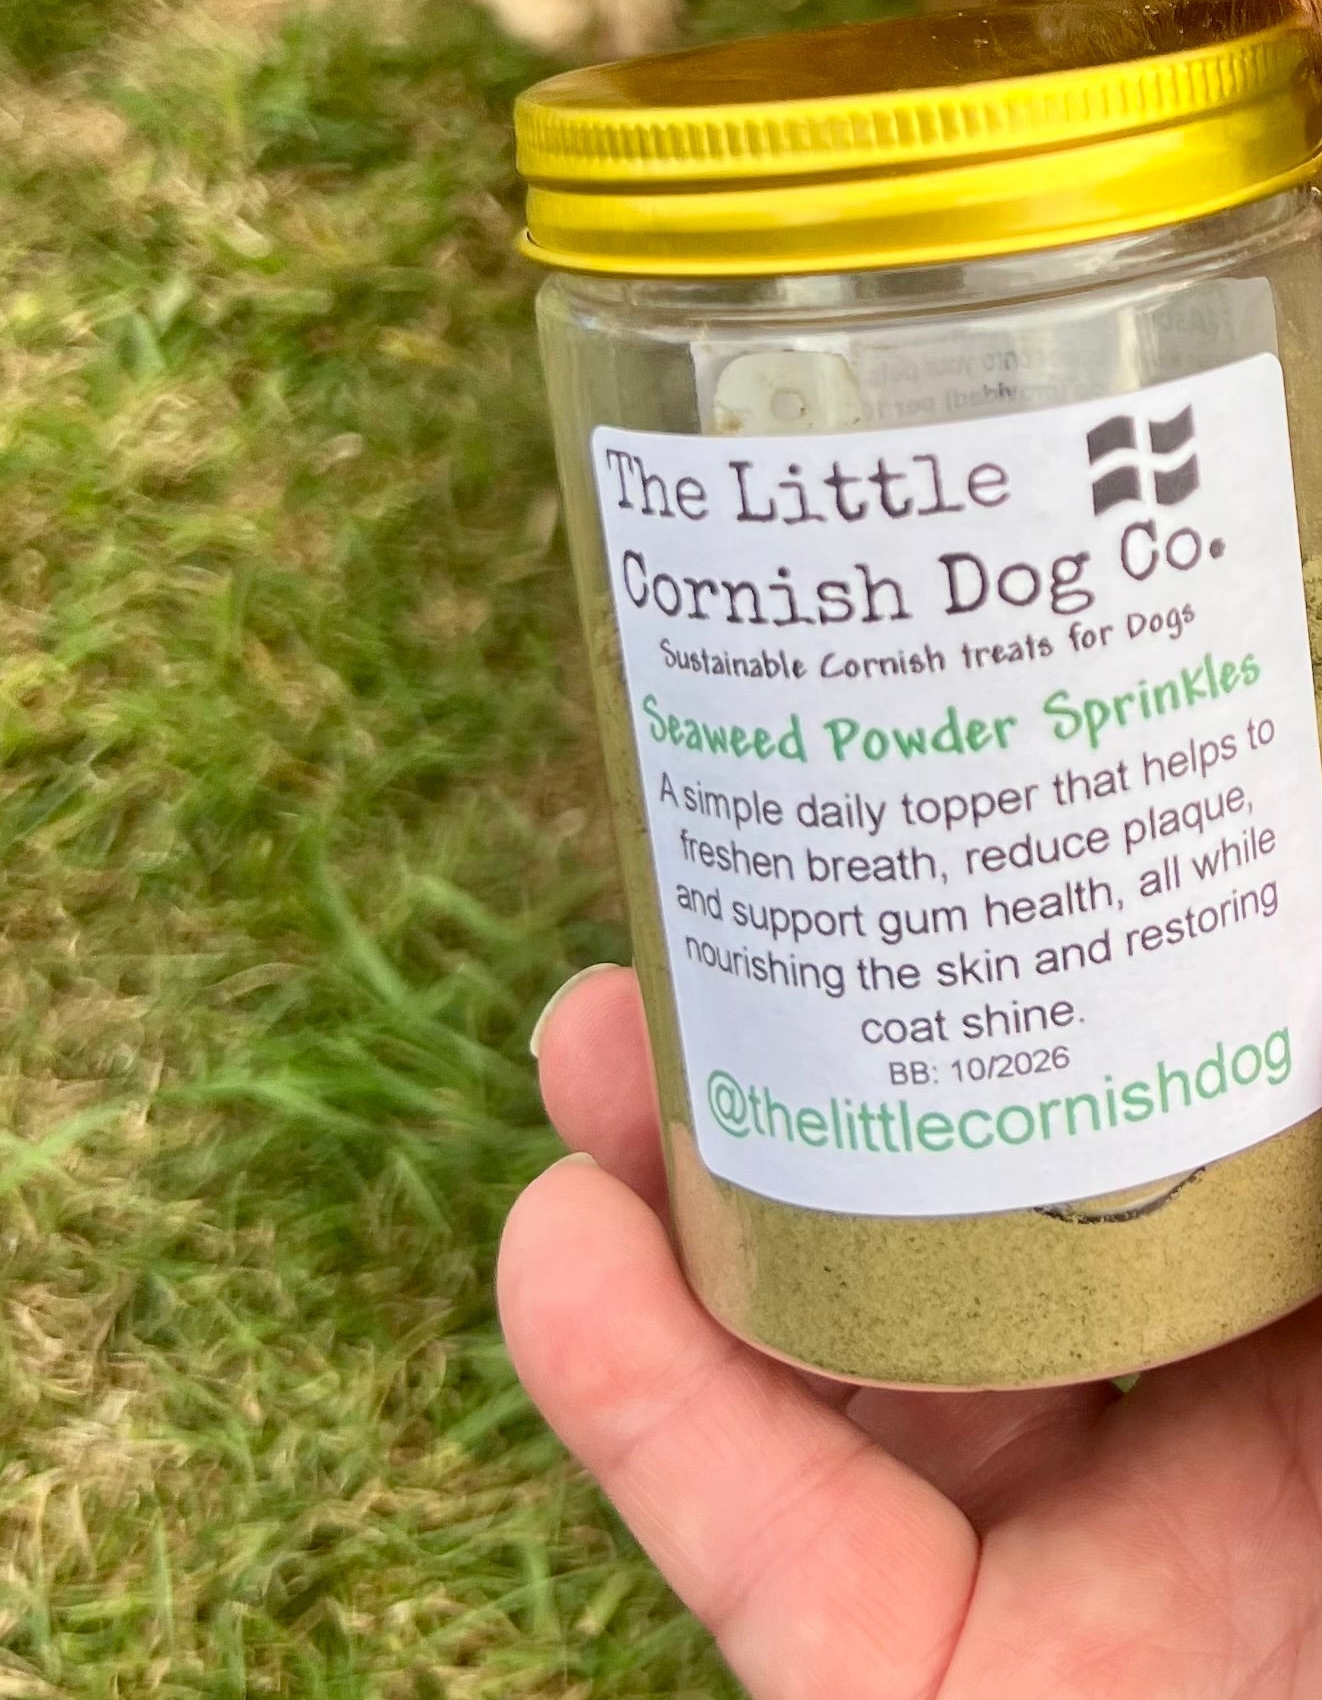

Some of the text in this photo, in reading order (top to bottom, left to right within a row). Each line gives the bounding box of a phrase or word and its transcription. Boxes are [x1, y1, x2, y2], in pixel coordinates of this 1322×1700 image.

[606, 447, 1011, 526] The Little
[621, 518, 1226, 628] Cornish Dog Co.
[659, 602, 1196, 680] Sustainable Cornish treats for Dogs
[640, 652, 1261, 764] Seaweed Powder Sprinkles
[659, 717, 1275, 837] A simple daily topper that helps to
[675, 825, 1276, 947] and support gum health, all while
[679, 785, 1255, 885] freshen breath, reduce plaque,
[684, 879, 1279, 1000] nourishing the skin and restoring
[860, 999, 1086, 1045] coat shine.
[888, 1044, 1071, 1087] BB: 10/2026
[706, 1025, 1292, 1154] @thelittlecornishdog
